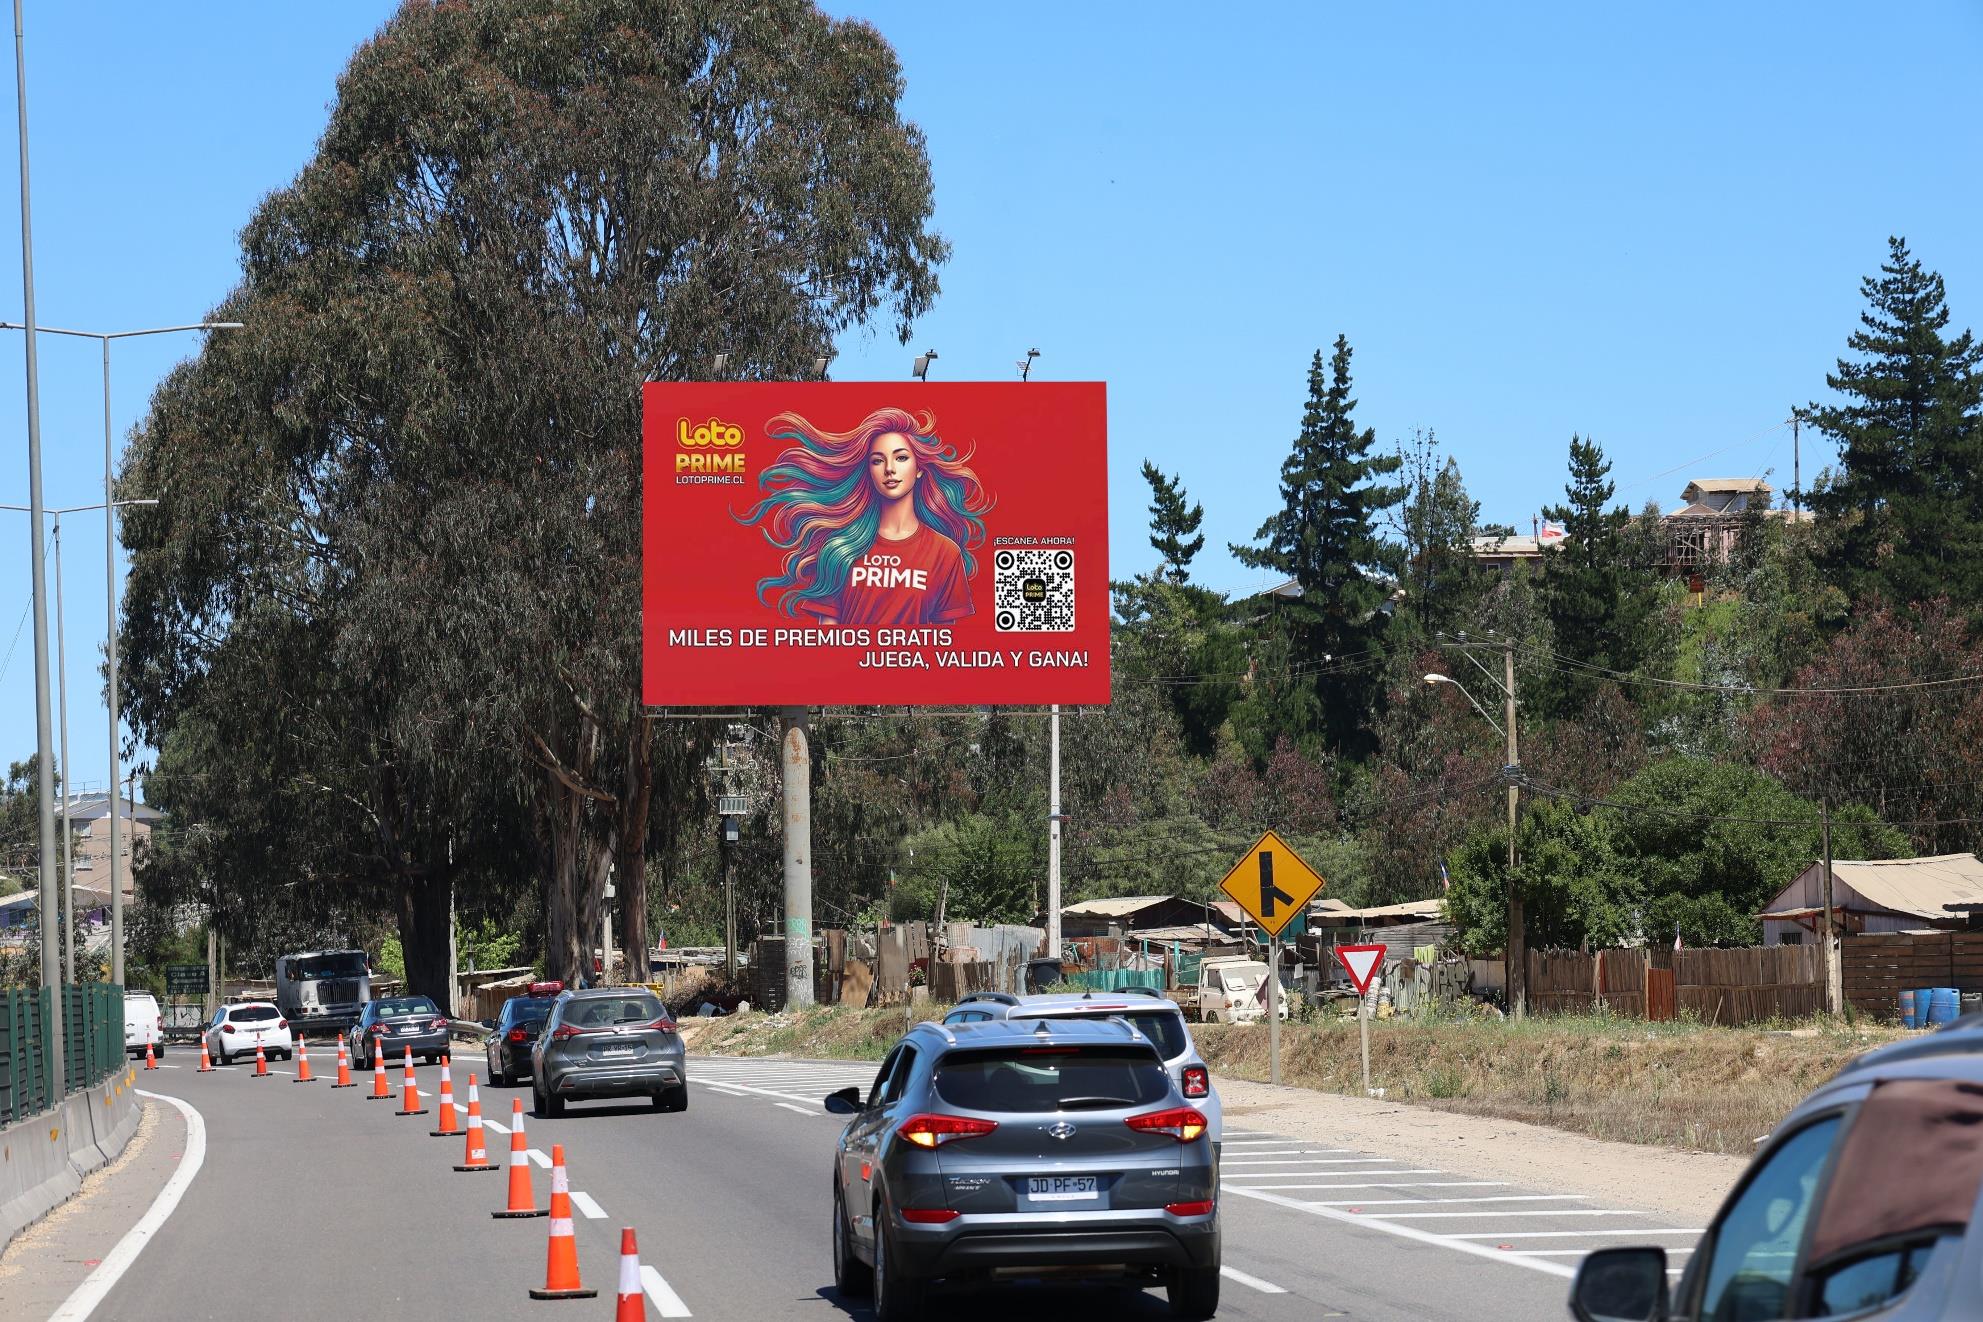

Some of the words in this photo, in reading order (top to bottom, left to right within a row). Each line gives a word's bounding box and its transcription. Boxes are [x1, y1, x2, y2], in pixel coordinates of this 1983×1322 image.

[679, 419, 743, 447] Loto
[675, 453, 746, 473] PRIME
[676, 475, 745, 484] LOTOPRIME.CL
[993, 536, 1038, 546] ¡ESCANEA
[1041, 537, 1075, 545] AHORA!
[863, 554, 901, 567] LOTO
[851, 566, 928, 591] PRIME
[669, 629, 732, 646] MILES
[739, 629, 768, 646] DE
[774, 629, 870, 646] PREMIOS
[877, 629, 952, 646] GRATIS
[859, 651, 930, 670] JUEGA,
[935, 651, 1004, 667] VALIDA
[1010, 651, 1022, 667] Y
[1028, 651, 1088, 667] GANA!
